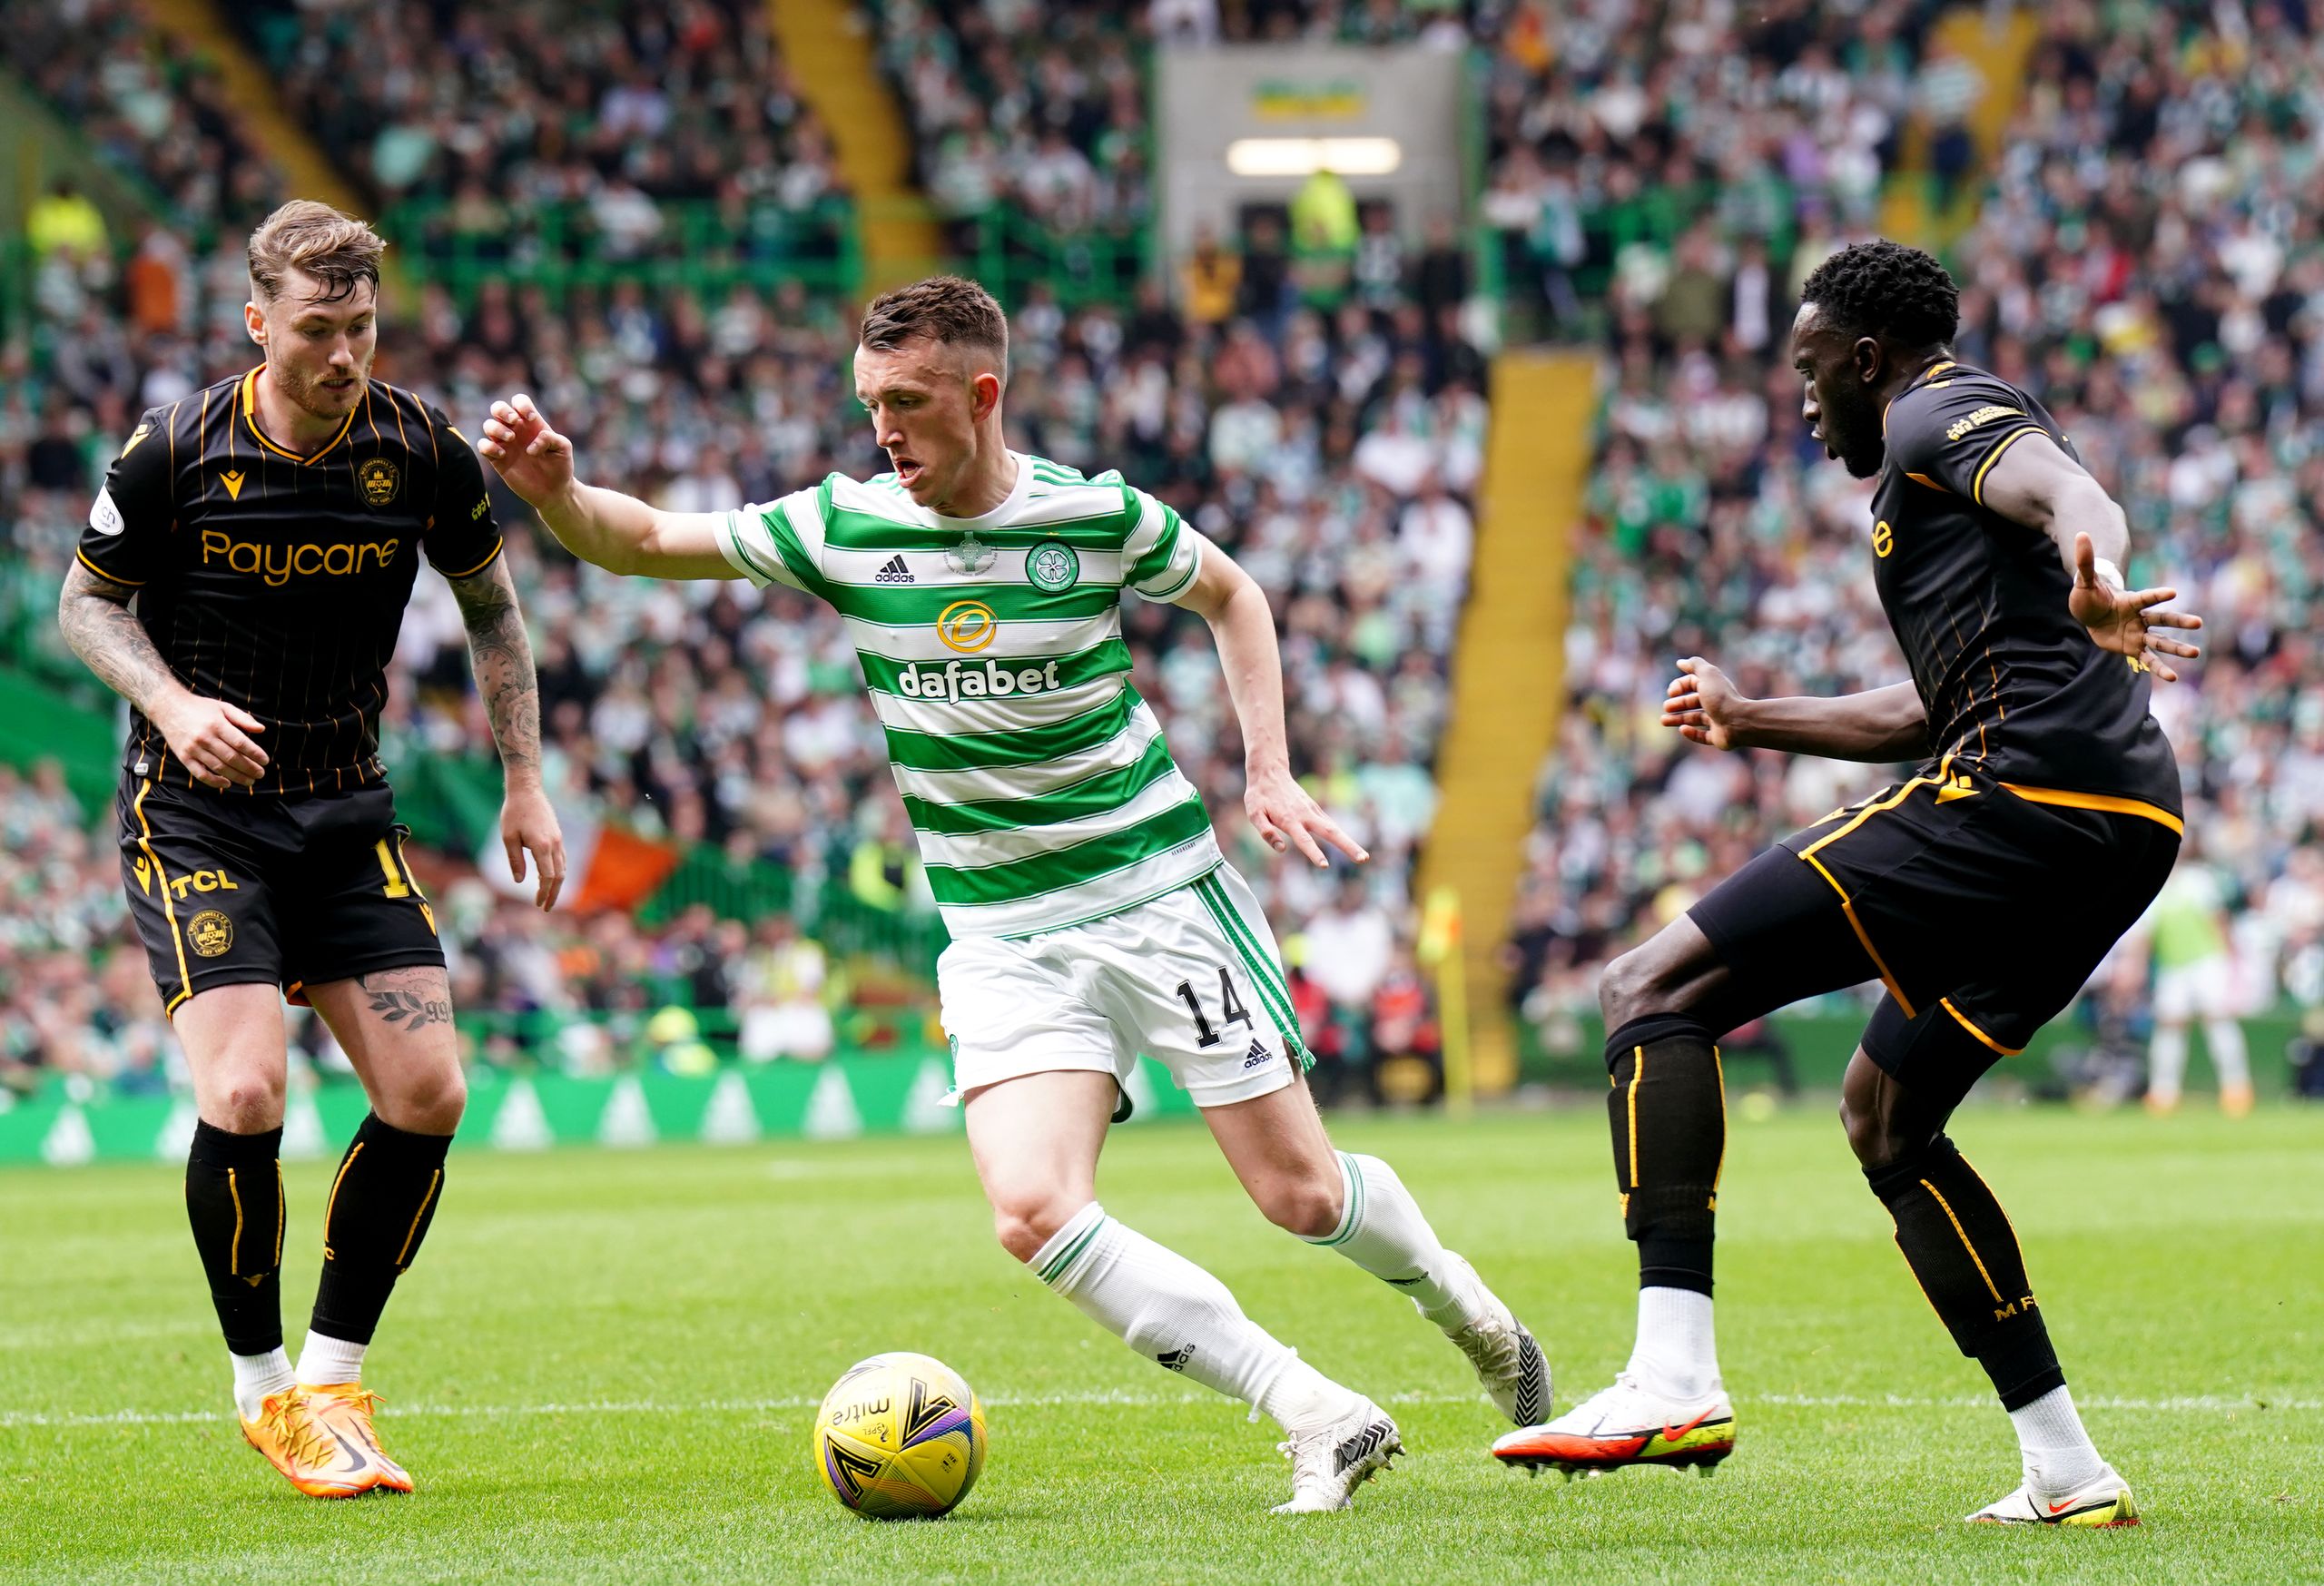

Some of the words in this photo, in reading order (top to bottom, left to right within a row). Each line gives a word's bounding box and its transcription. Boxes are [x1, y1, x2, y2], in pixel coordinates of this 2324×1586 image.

[202, 529, 399, 586] Paycare
[875, 572, 915, 583] adidas
[898, 657, 1060, 705] dafabet
[170, 870, 238, 899] TCL
[1176, 965, 1255, 1049] 14
[832, 1398, 890, 1426] mitre
[862, 1425, 882, 1435] SPFL
